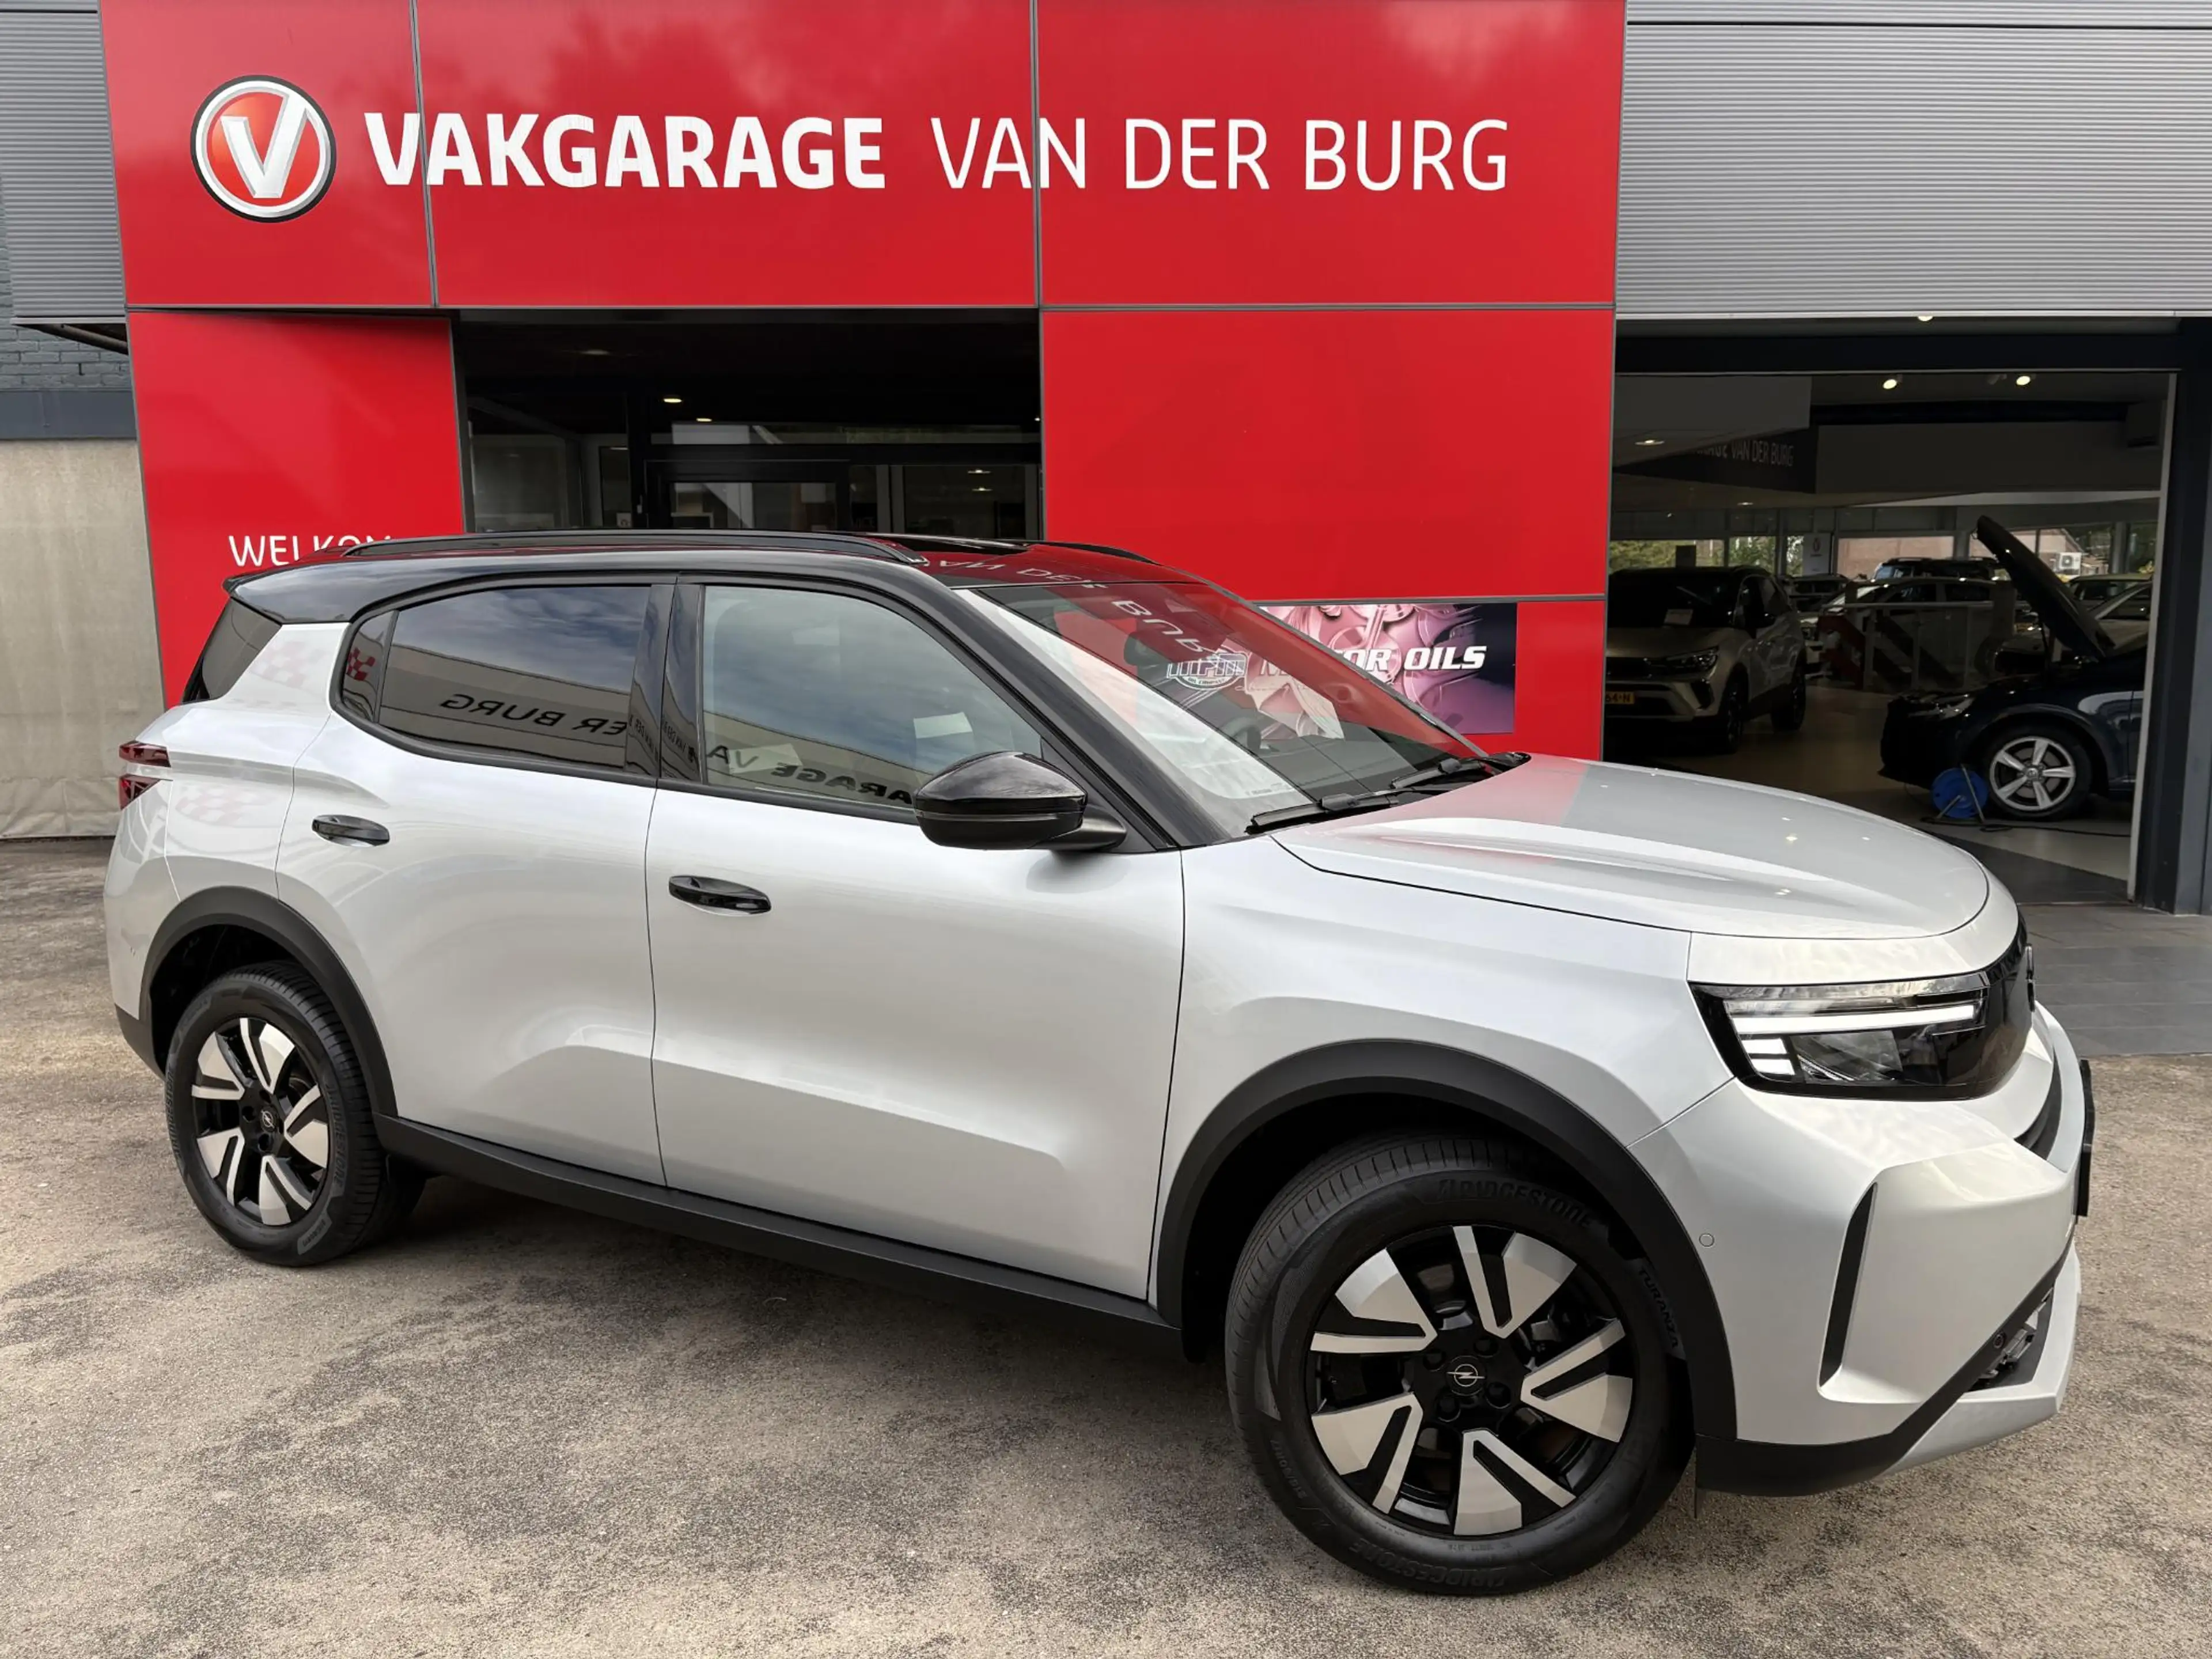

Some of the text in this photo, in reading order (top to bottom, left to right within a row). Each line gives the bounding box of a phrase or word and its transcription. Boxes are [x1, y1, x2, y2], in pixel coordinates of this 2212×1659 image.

[364, 113, 1507, 190] VAKGARAGE VAN DER BURG
[1404, 646, 1487, 669] OILS
